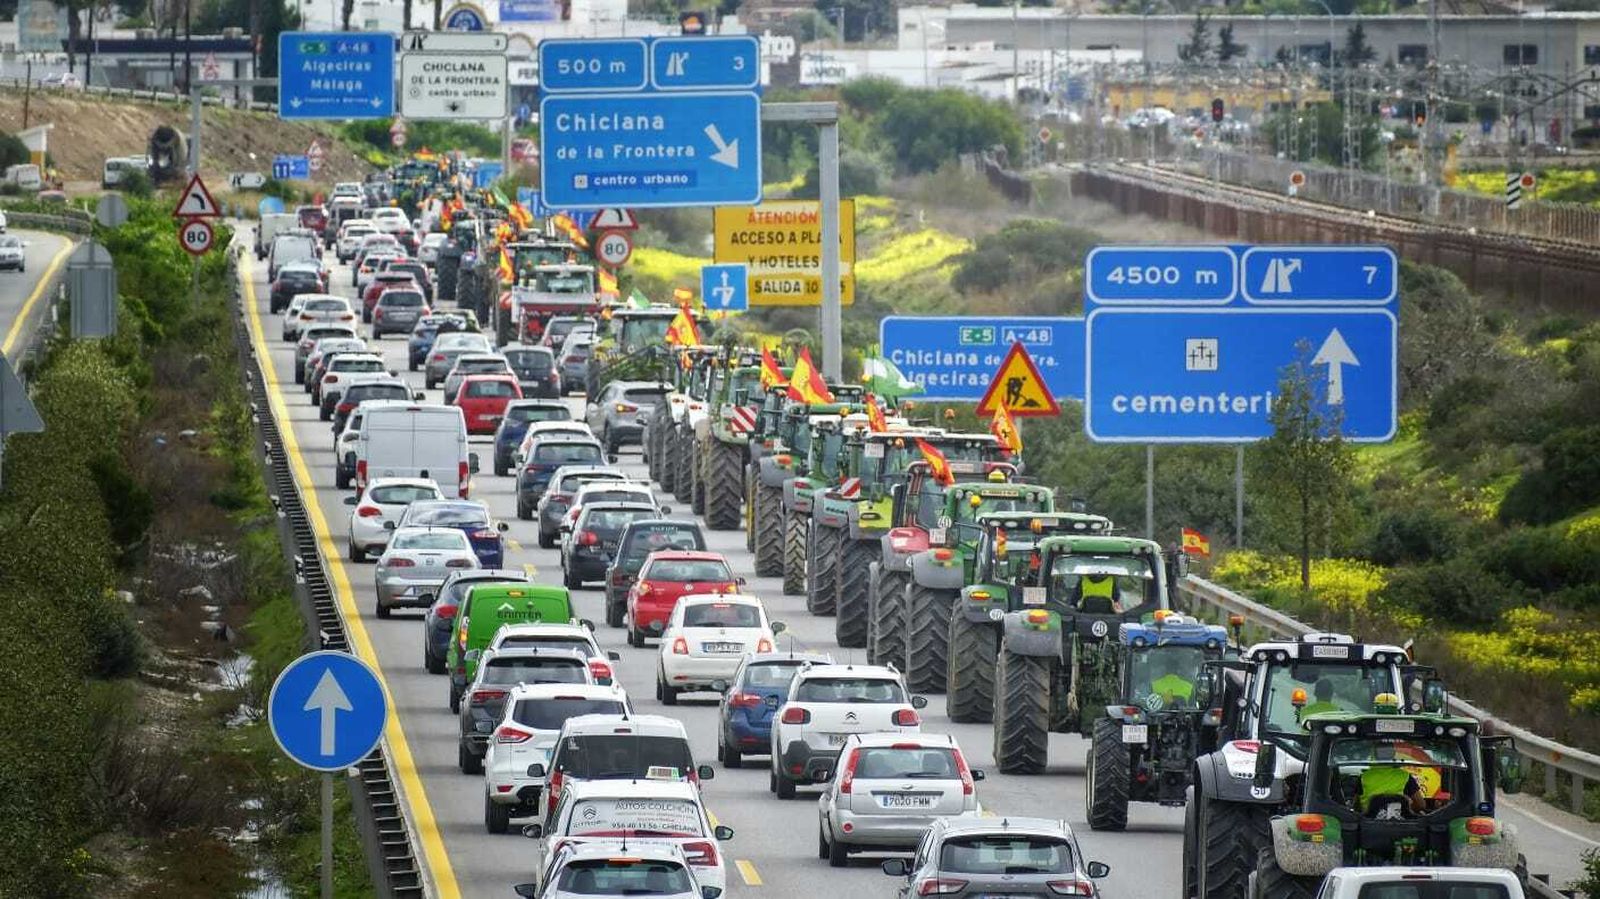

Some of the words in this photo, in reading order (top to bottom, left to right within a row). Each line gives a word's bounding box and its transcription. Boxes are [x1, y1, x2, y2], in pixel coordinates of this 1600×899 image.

[303, 61, 372, 75] Algeciras
[423, 62, 485, 72] CHICLANA
[558, 58, 601, 74] 500
[609, 60, 626, 73] m
[732, 56, 745, 71] 3
[411, 76, 424, 85] DE
[428, 76, 441, 85] LA
[445, 76, 499, 85] FRONTERA
[428, 89, 459, 97] centro
[462, 89, 496, 97] urbano
[556, 113, 666, 132] Chiclana
[556, 146, 577, 160] de
[587, 145, 604, 159] la
[613, 143, 696, 159] Frontera
[593, 175, 637, 186] centro
[643, 173, 689, 185] urbano
[187, 231, 207, 243] 80
[731, 231, 785, 245] ACCESO
[788, 231, 797, 244] A
[604, 243, 626, 255] 80
[748, 255, 756, 267] Y
[759, 255, 820, 268] HOTELES
[1106, 266, 1181, 285] 4500
[1195, 270, 1218, 285] m
[1362, 265, 1378, 285] 7
[754, 280, 801, 294] SALIDA
[806, 281, 818, 293] 10
[961, 329, 993, 342] E-5
[1005, 329, 1050, 342] A-48
[891, 350, 979, 366] Chiclana
[984, 354, 1000, 366] de
[907, 370, 990, 387] lgeciras
[1111, 391, 1283, 414] cementeri
[889, 796, 911, 807] 7020
